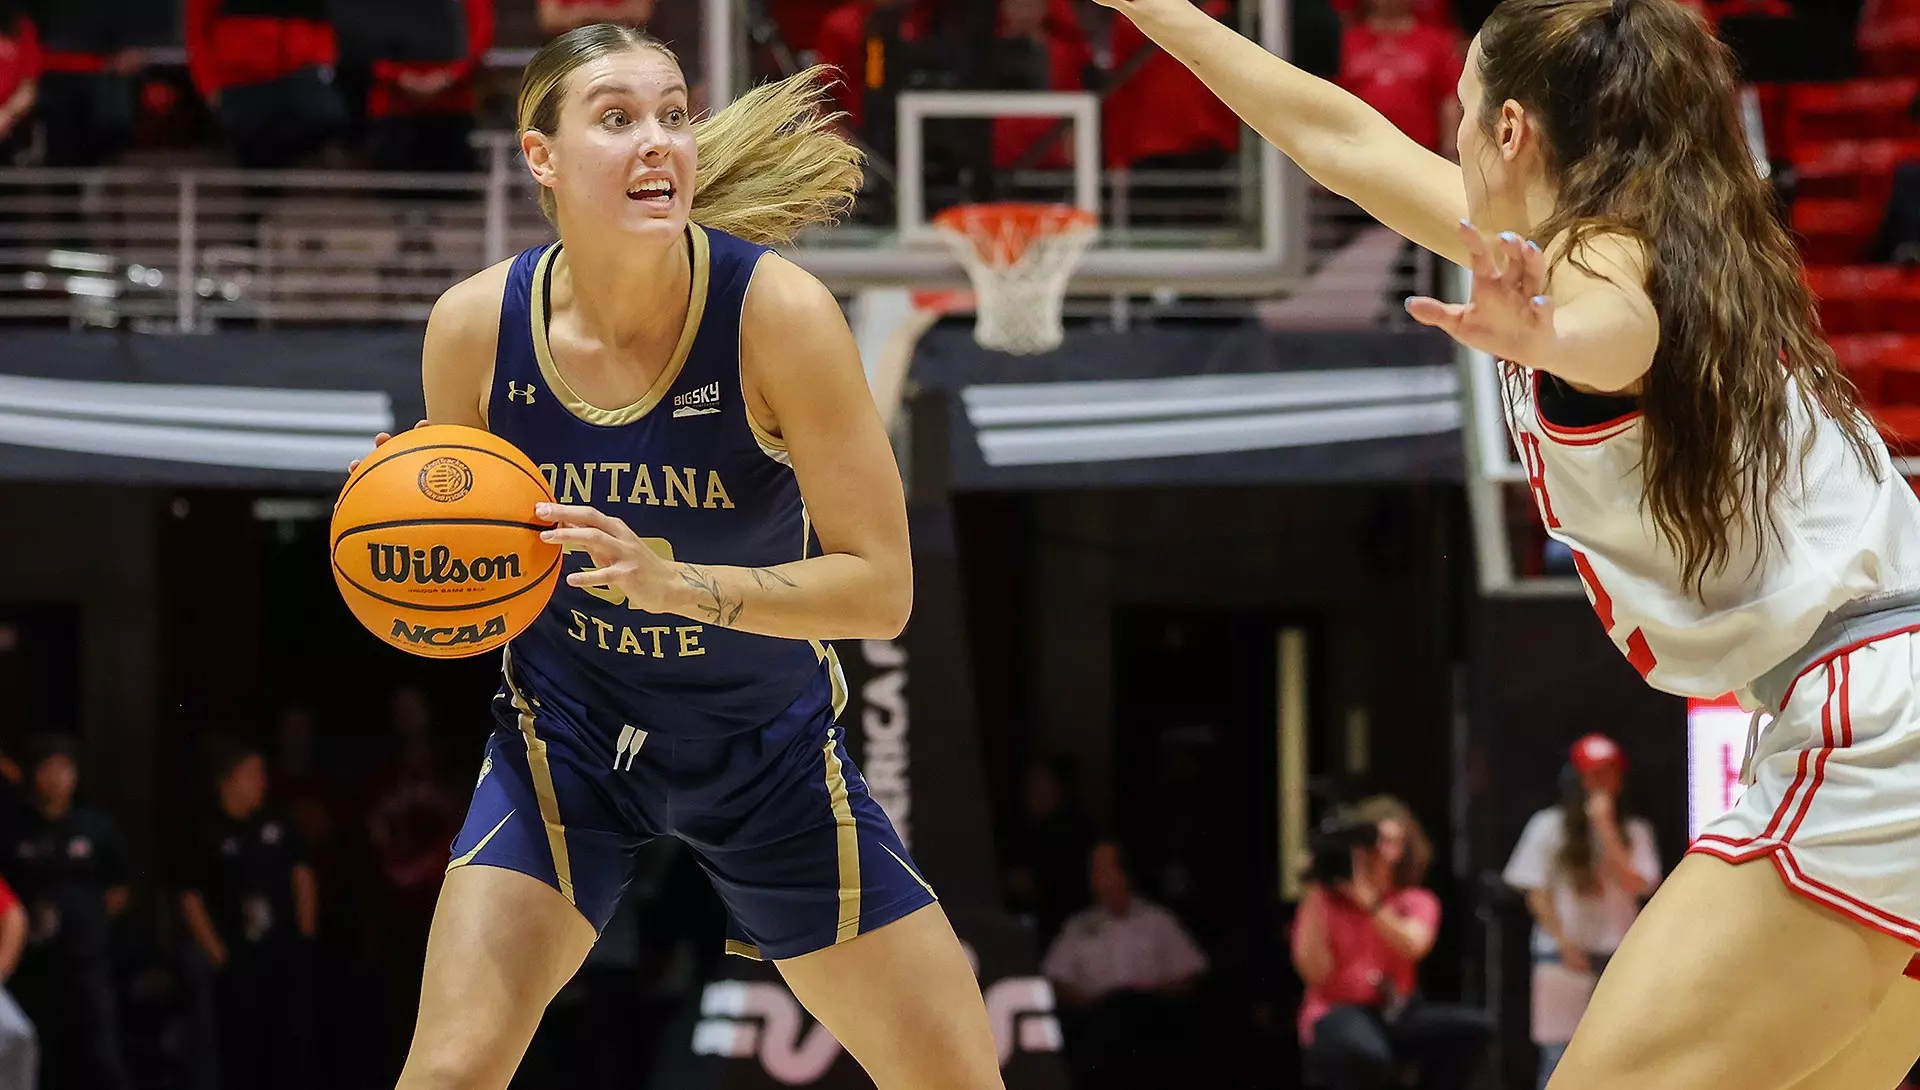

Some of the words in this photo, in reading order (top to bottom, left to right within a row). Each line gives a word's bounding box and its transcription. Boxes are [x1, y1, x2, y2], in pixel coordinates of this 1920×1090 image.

[538, 462, 736, 509] ONTANA
[367, 543, 521, 584] Wilson
[391, 614, 506, 646] NCAA
[567, 609, 706, 658] STATE
